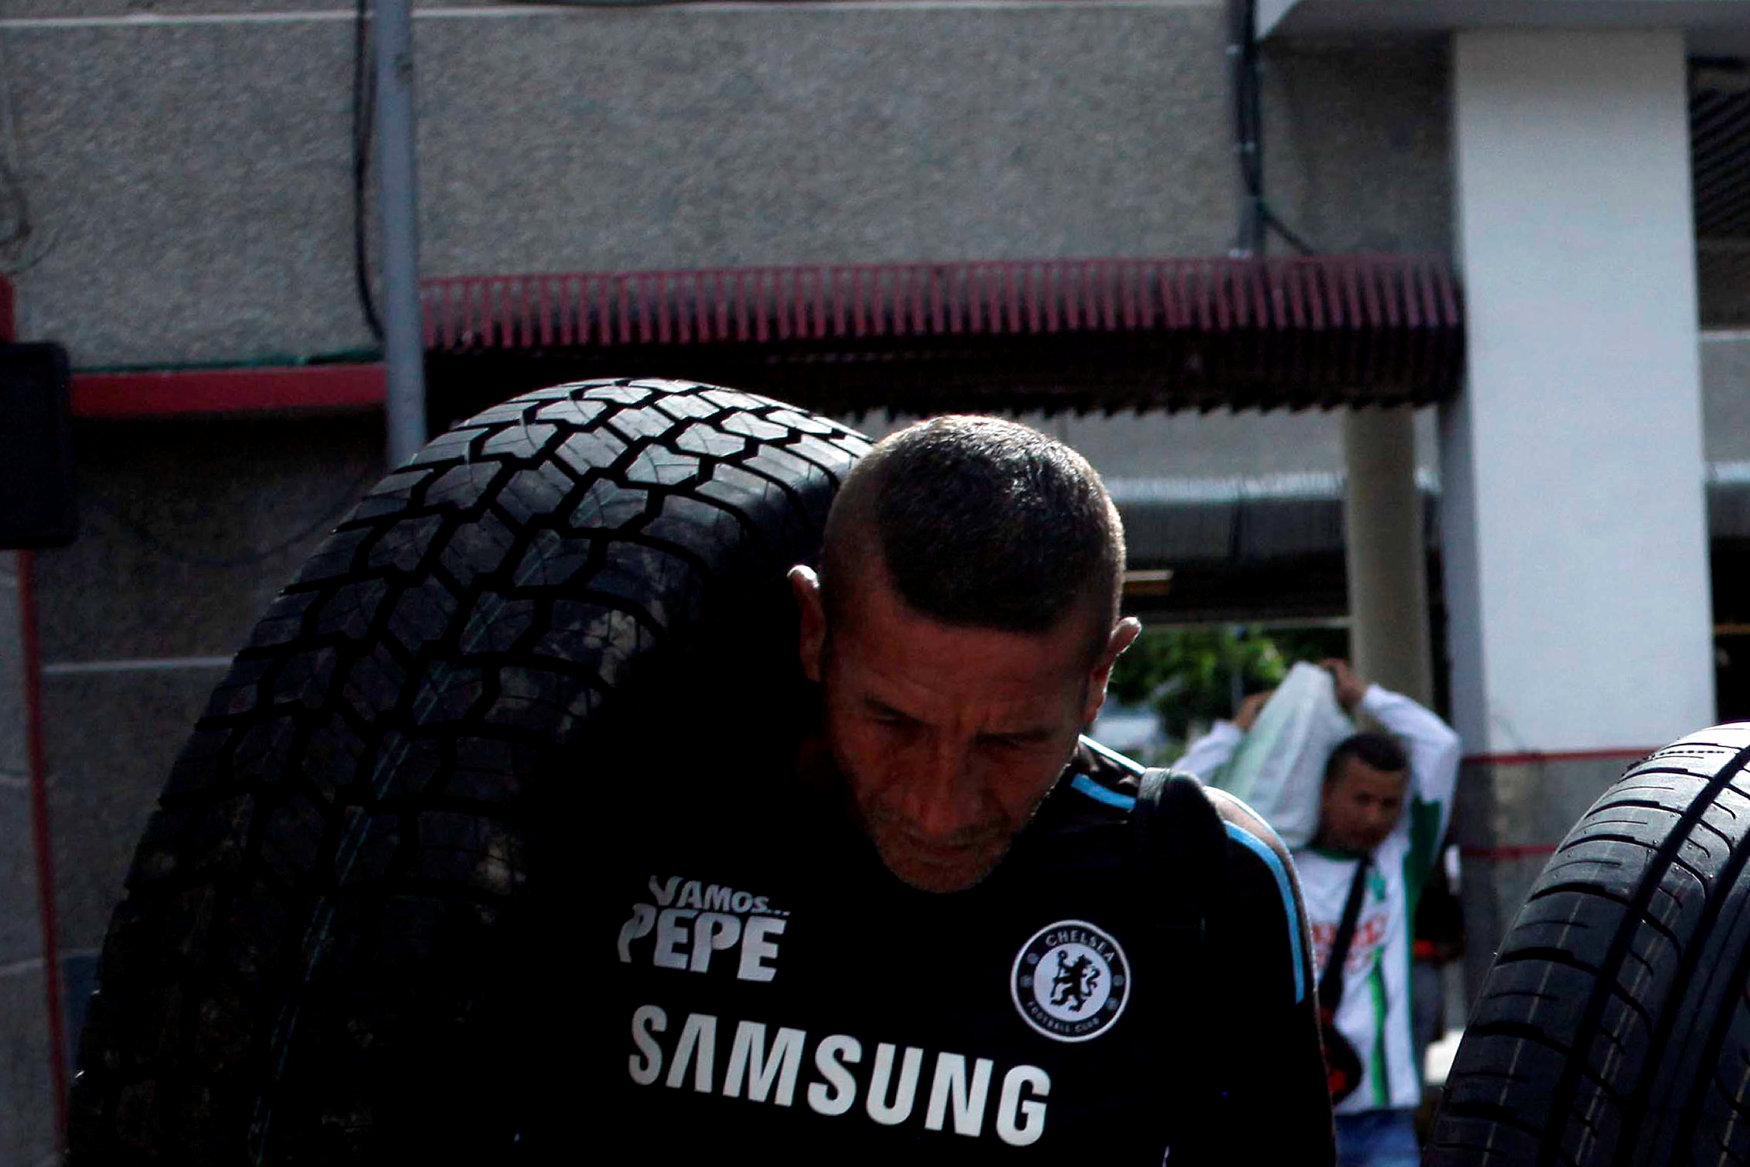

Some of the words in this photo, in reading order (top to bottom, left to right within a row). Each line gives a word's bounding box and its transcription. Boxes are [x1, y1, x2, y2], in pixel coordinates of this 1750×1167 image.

[616, 903, 788, 983] PEPE
[1044, 929, 1115, 962] CHELSEA
[627, 1003, 1052, 1148] SAMSUNG
